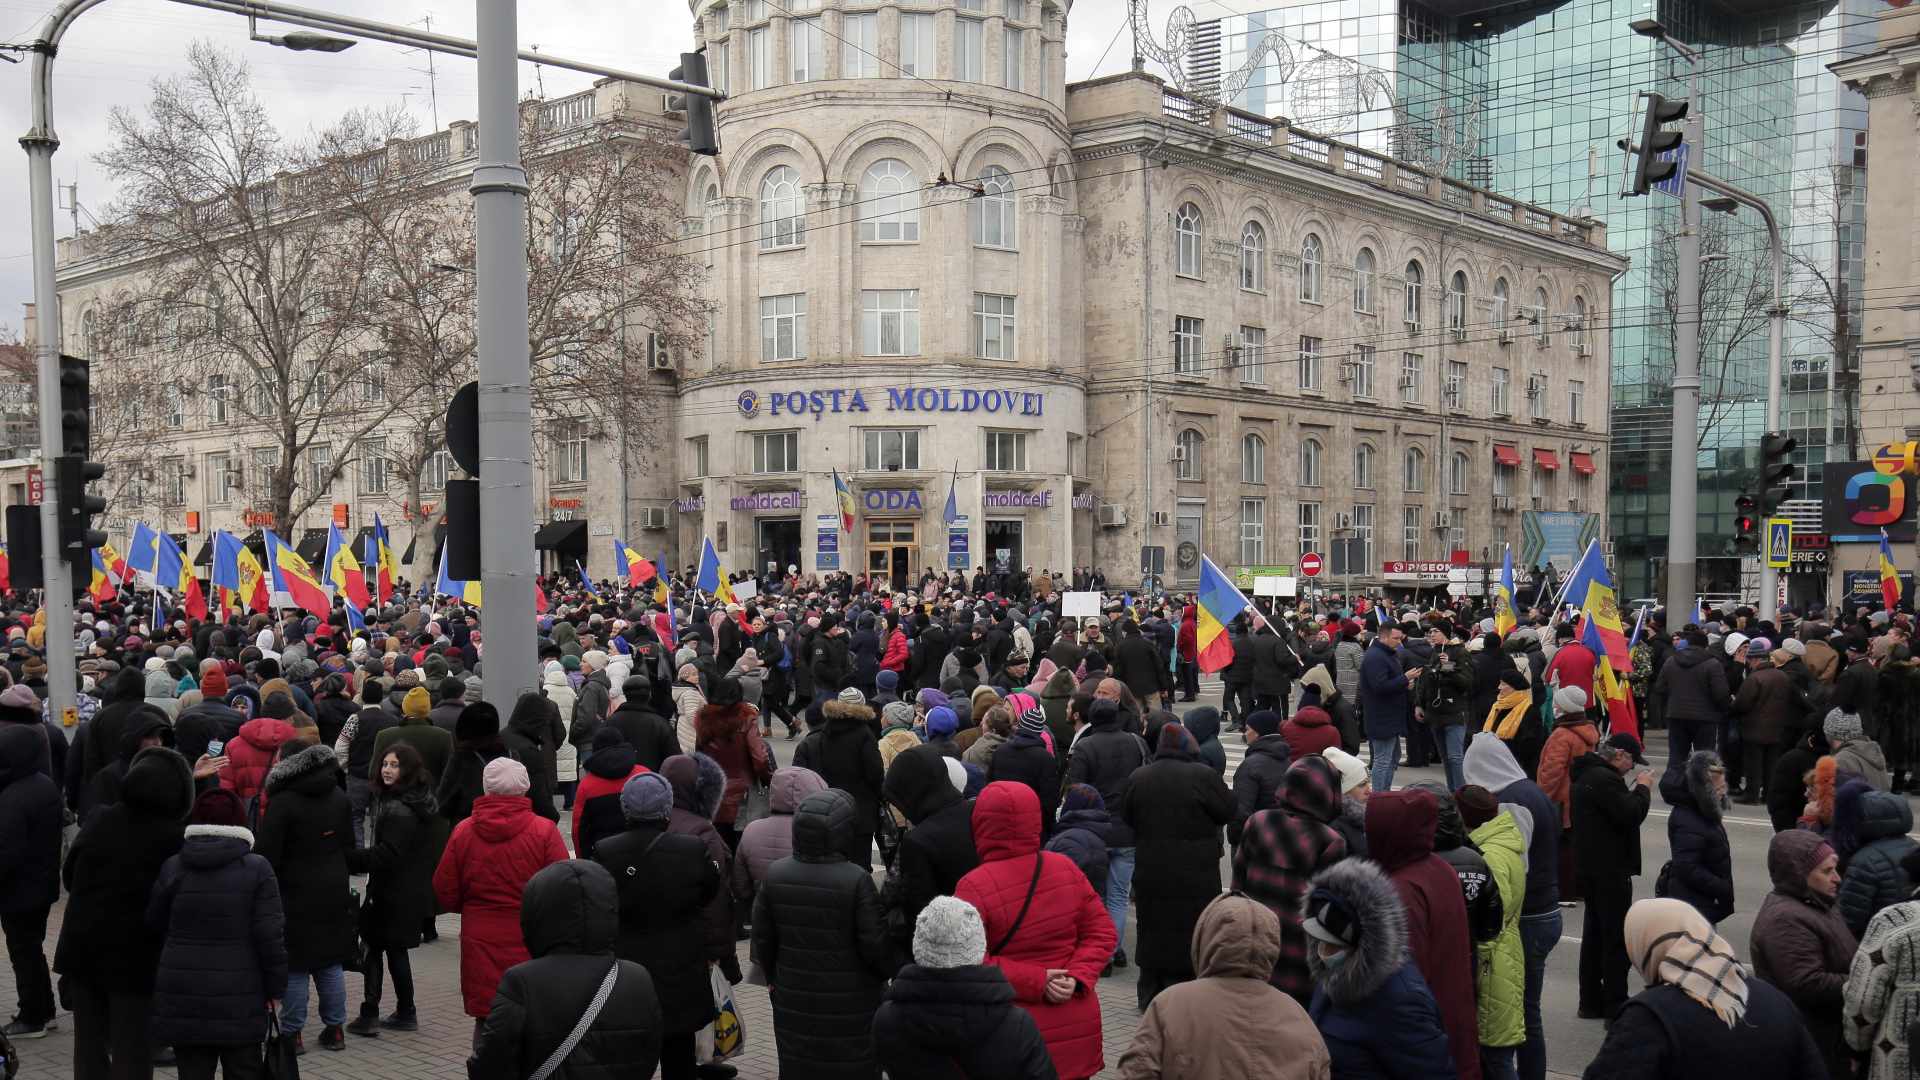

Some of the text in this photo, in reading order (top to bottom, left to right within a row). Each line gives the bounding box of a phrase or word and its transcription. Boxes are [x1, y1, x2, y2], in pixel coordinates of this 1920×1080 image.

[770, 387, 1044, 421] POȘTA MOLDOVEI
[550, 497, 580, 509] Orange
[731, 491, 800, 510] moldcell
[865, 489, 922, 510] ODA
[984, 490, 1048, 508] moldcell
[242, 508, 276, 530] Orang
[555, 511, 573, 523] 24/7
[1541, 516, 1555, 526] RAME
[1560, 516, 1581, 526] BAGHETE
[1792, 535, 1828, 547] TOO
[1790, 552, 1815, 562] ERIE
[1408, 563, 1455, 572] PIGEON
